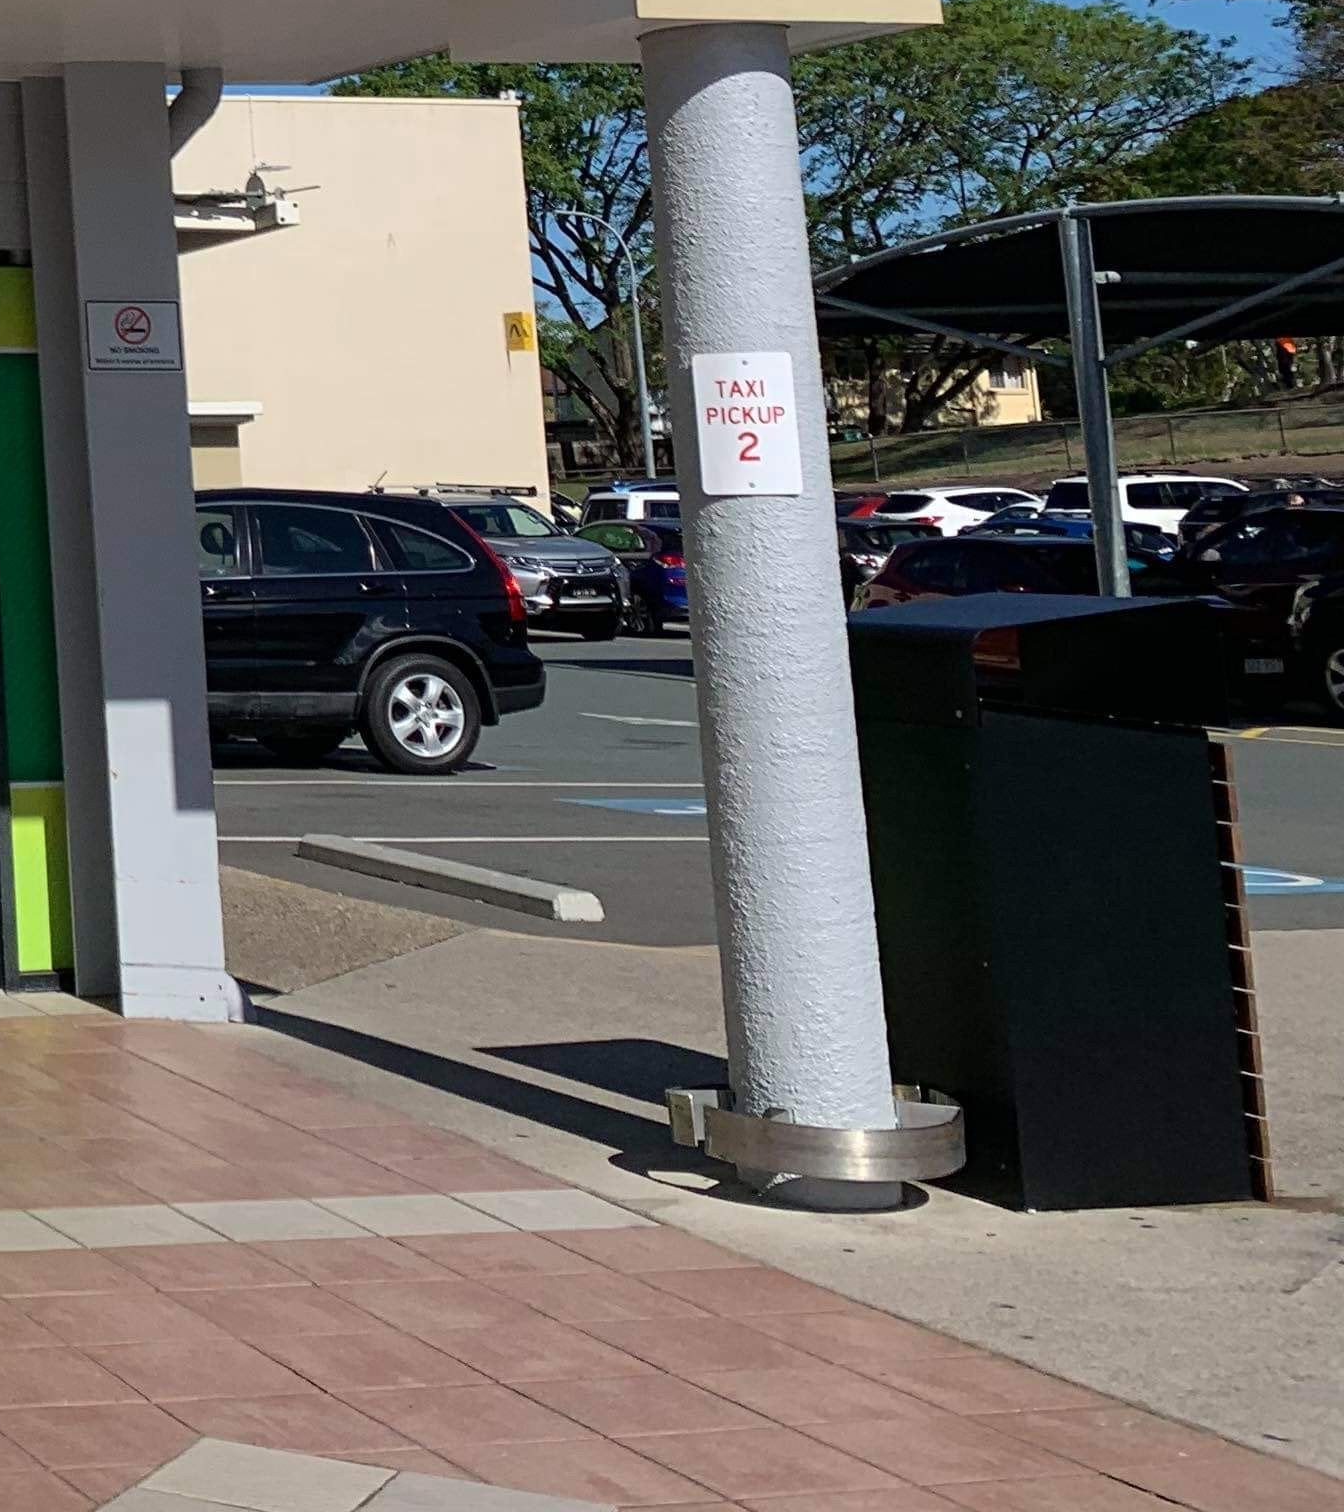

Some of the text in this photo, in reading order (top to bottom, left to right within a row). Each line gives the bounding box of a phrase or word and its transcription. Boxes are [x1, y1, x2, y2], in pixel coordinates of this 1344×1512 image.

[714, 379, 766, 399] TAXI
[705, 405, 786, 425] PICKUP
[737, 431, 761, 462] 2
